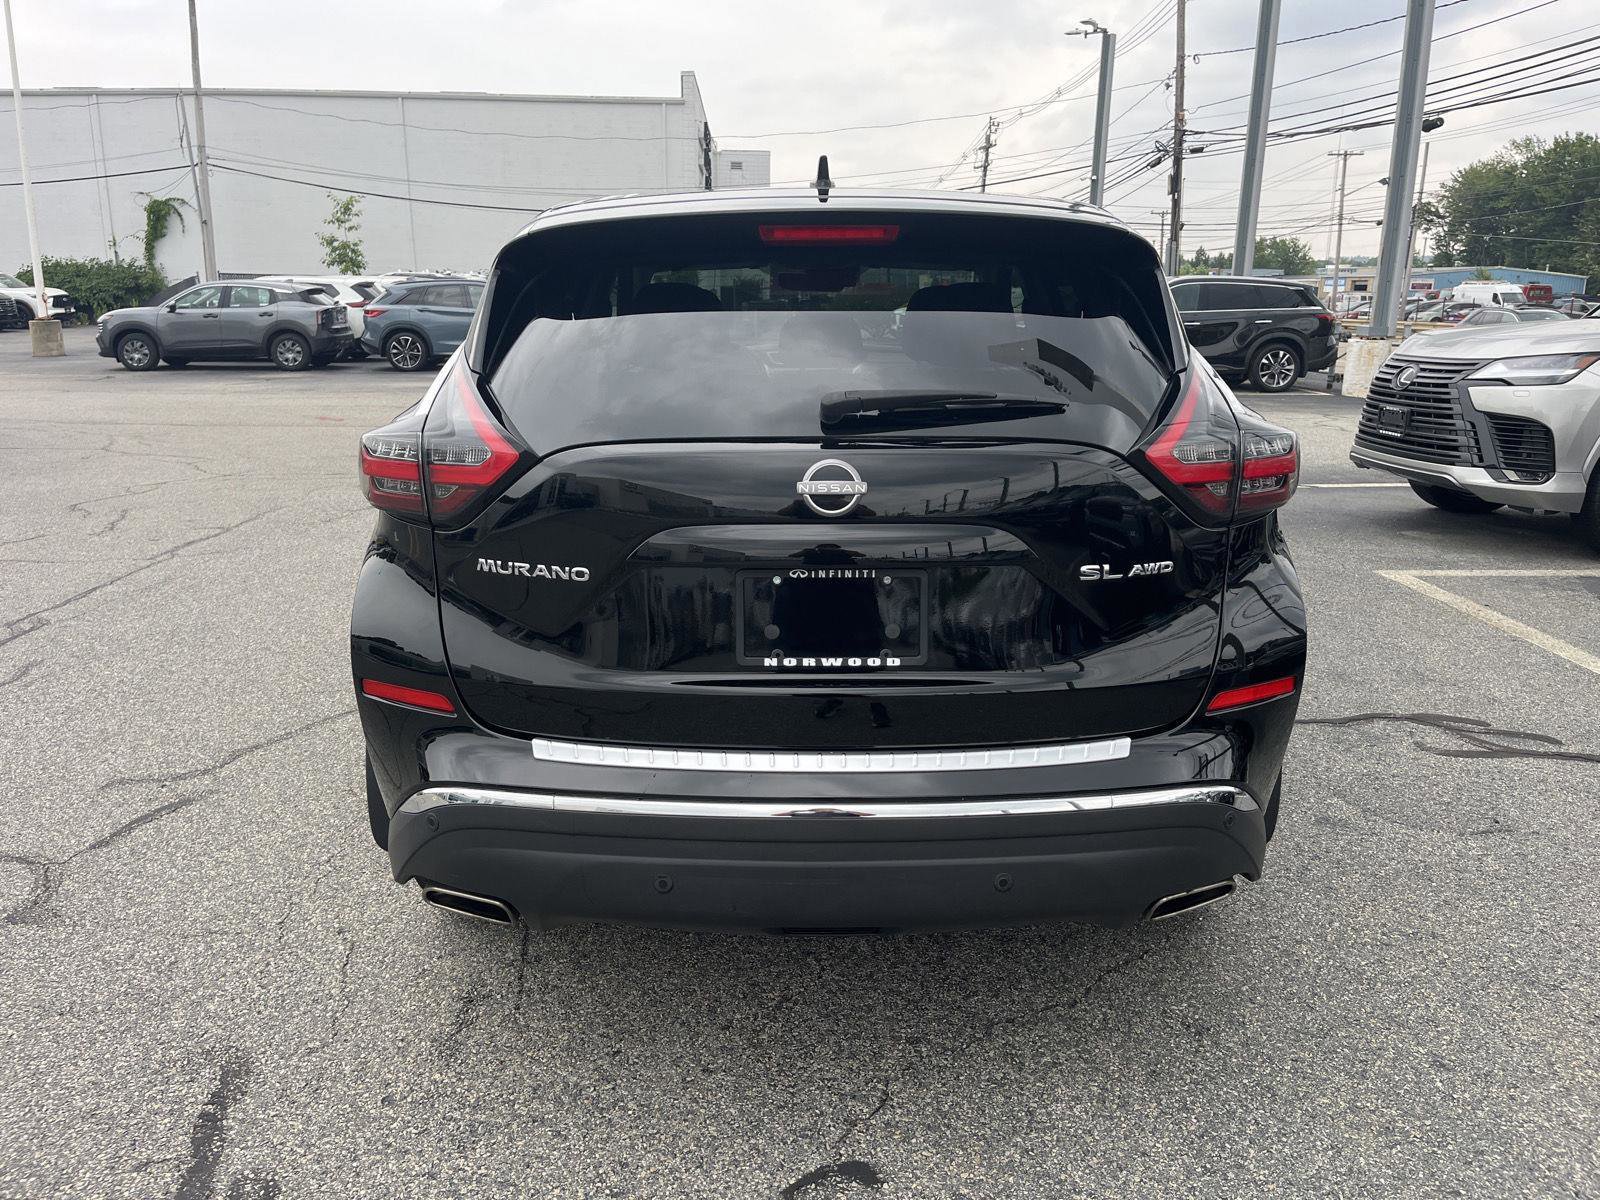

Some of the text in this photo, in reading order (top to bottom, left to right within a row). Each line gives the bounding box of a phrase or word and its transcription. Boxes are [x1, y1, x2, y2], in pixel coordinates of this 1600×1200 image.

[799, 484, 866, 493] NISSAN
[476, 558, 590, 581] MURANO
[811, 569, 876, 579] INFINITI
[1079, 561, 1174, 581] SL AWD
[763, 657, 901, 667] NORWOOD
